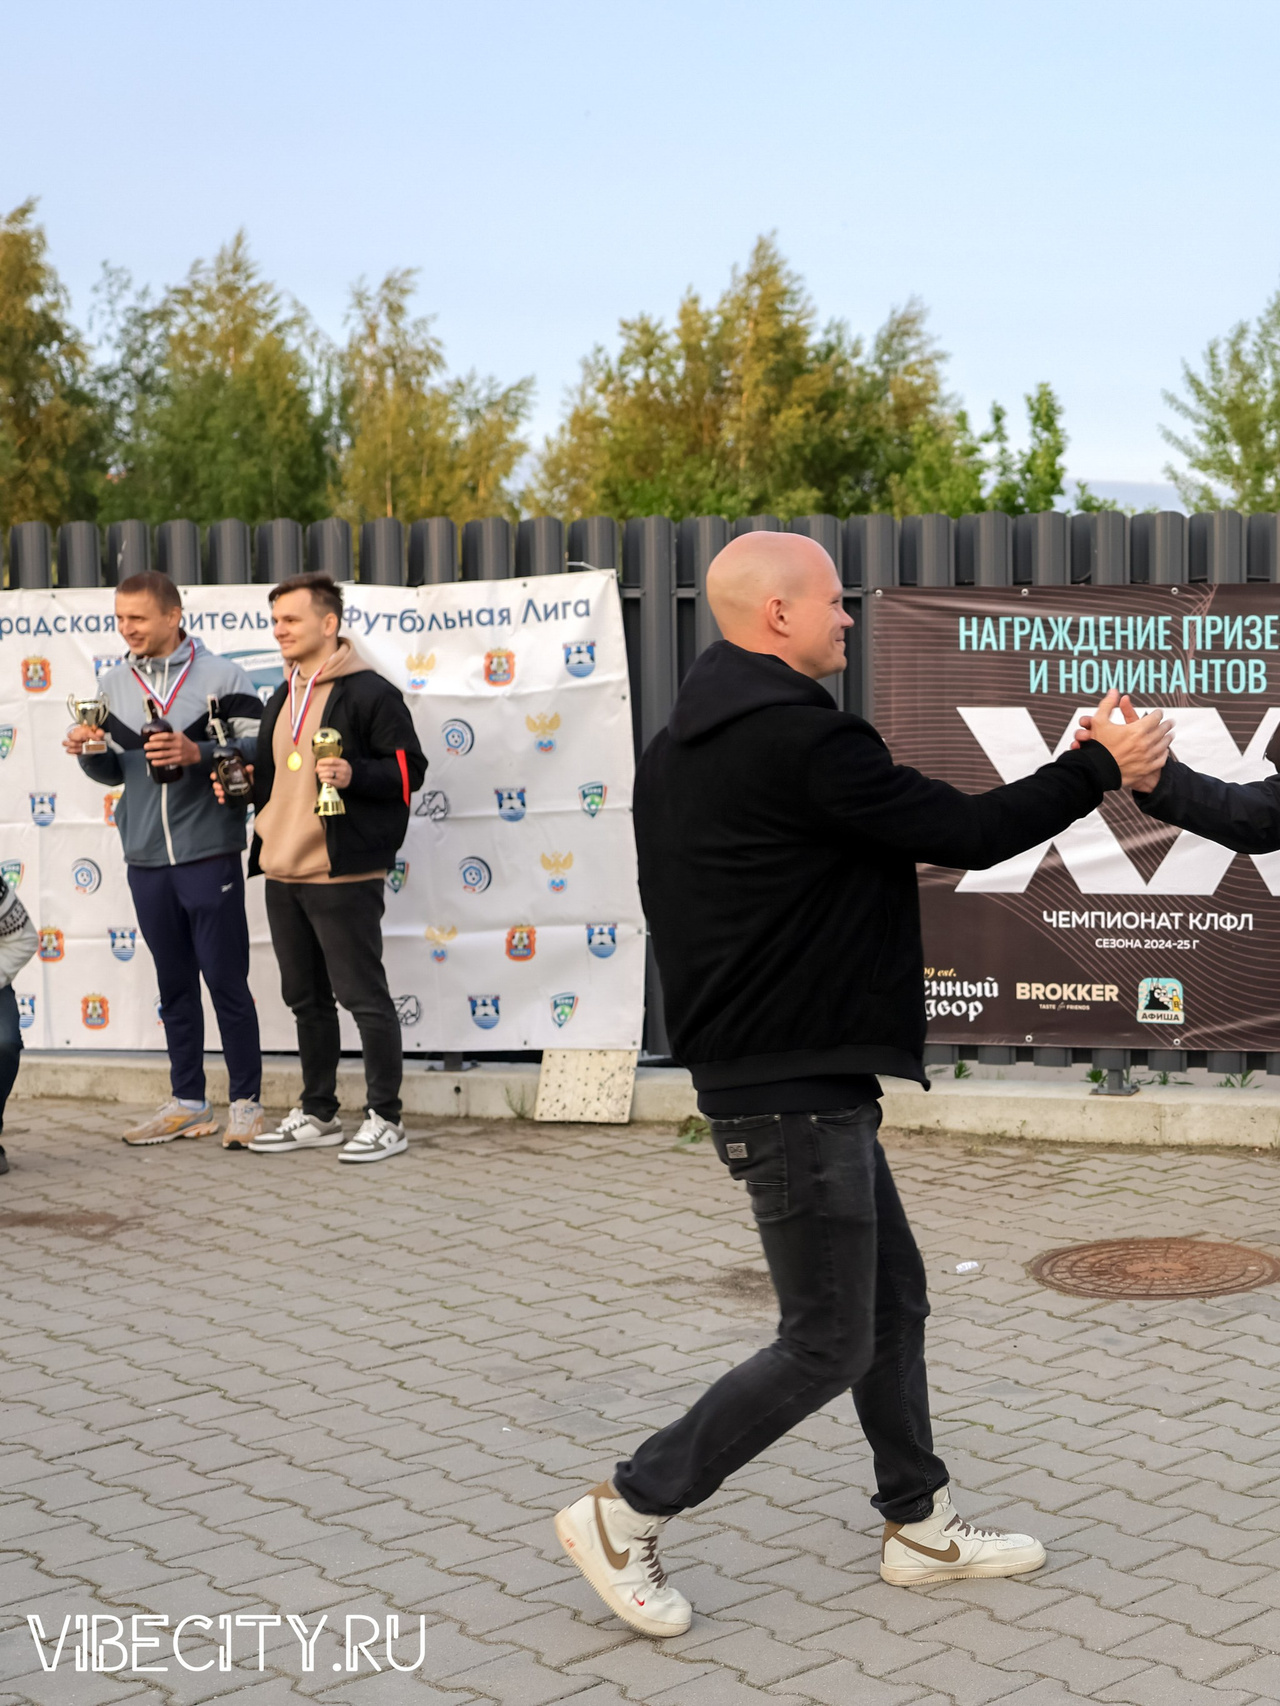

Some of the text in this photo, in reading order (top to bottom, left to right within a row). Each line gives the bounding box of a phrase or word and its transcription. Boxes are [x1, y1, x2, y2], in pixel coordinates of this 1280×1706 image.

[181, 611, 275, 630] итель
[521, 599, 590, 623] Лига
[958, 616, 1172, 656] НАГРАЖДЕНИЕ
[1029, 659, 1267, 694] И НОМИНАНТОВ
[1043, 911, 1253, 931] ЧЕМПИОНАТ КЛФЛ
[1095, 938, 1200, 949] СЕЗОНА 2024-25 Г
[1016, 982, 1119, 1002] BROKKER
[1141, 1013, 1180, 1021] АФИША
